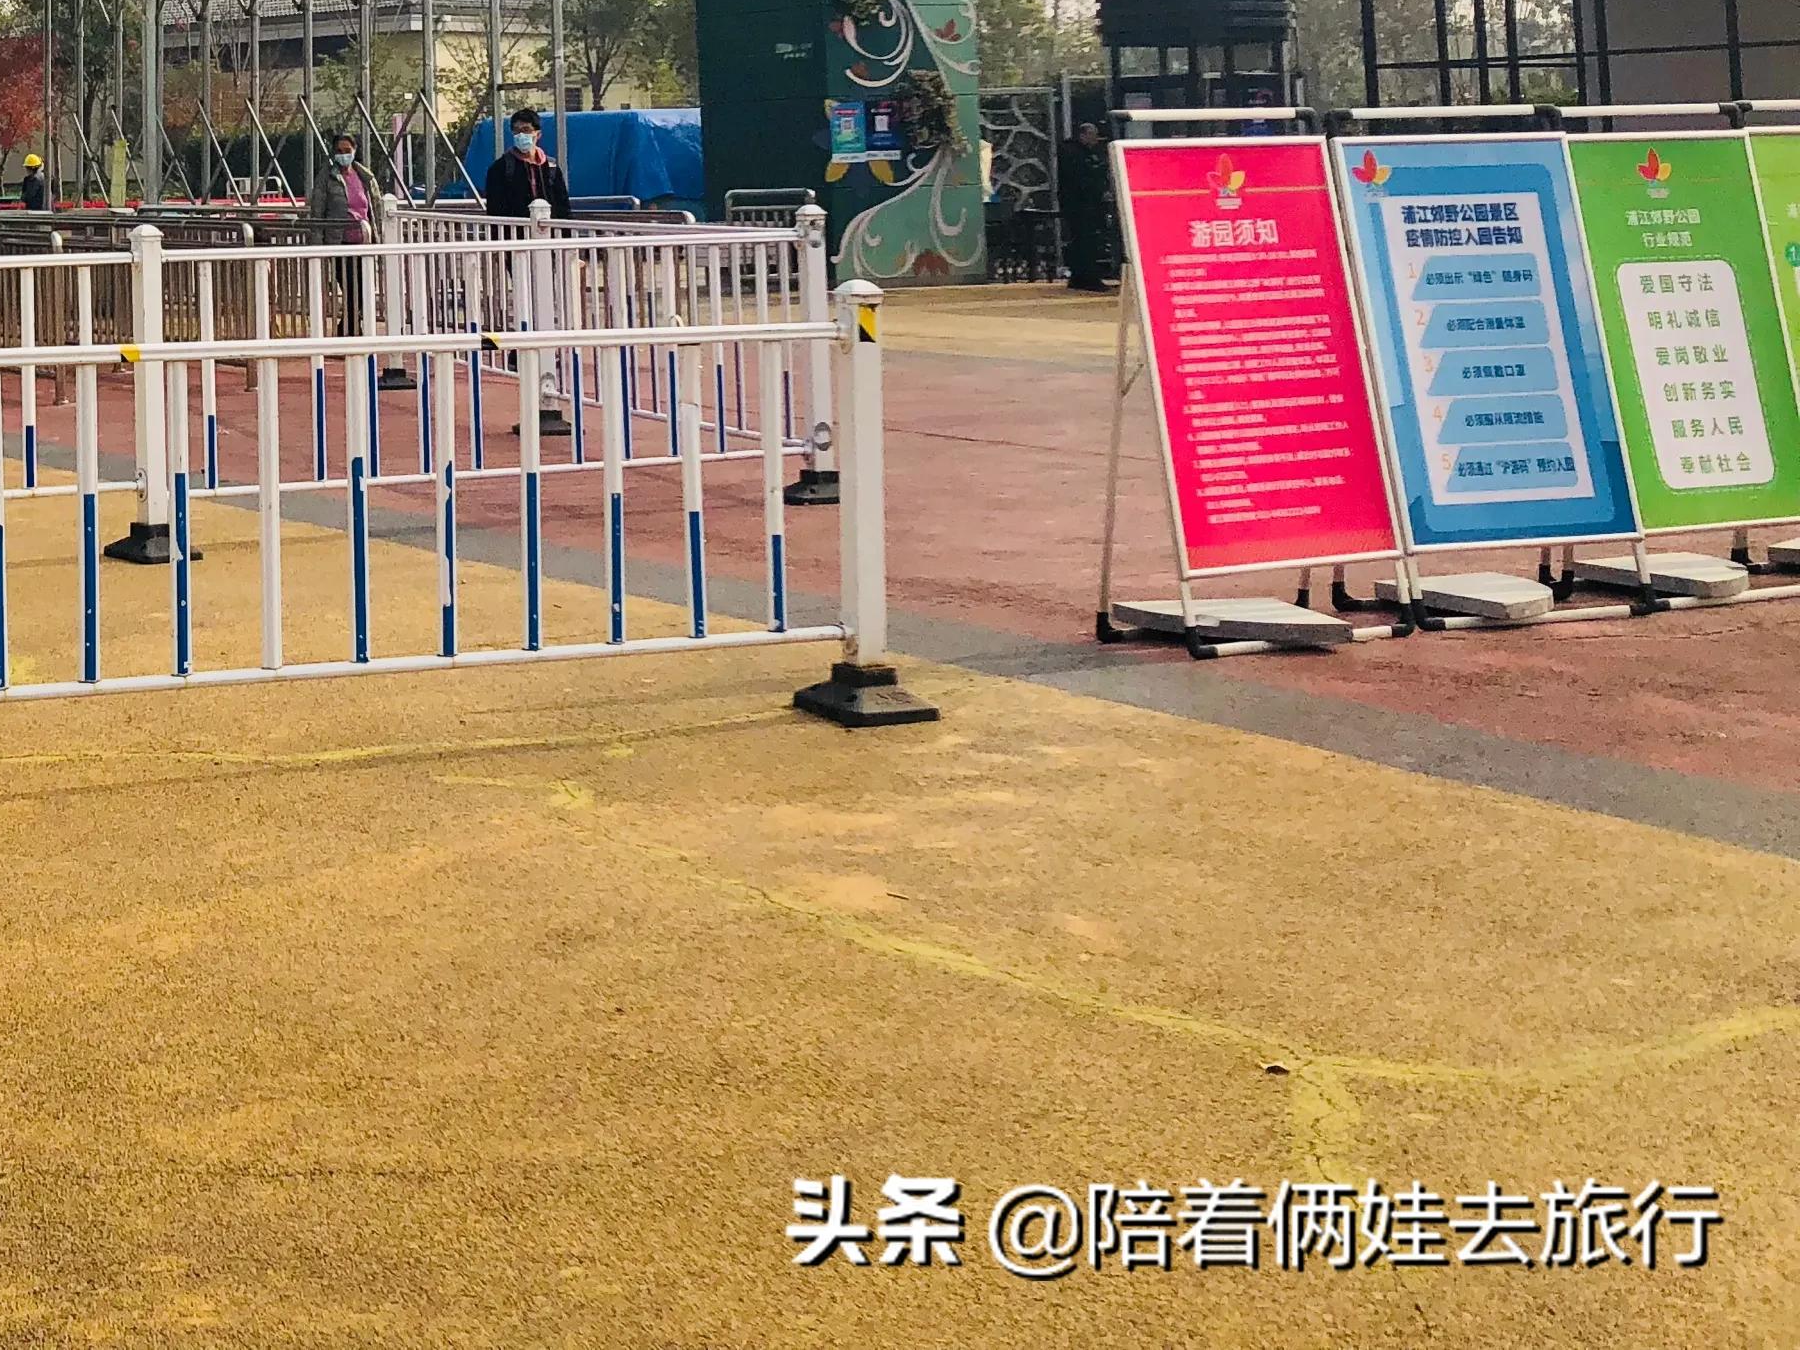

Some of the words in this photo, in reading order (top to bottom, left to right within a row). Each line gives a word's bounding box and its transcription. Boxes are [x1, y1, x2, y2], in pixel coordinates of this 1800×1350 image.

[1625, 208, 1701, 227] 浦江郊野公园
[1189, 219, 1279, 248] 游园须知
[1639, 272, 1714, 294] 爱国守法
[1647, 308, 1721, 330] 明礼诚信
[1654, 343, 1729, 366] 爱岗敬业
[1663, 380, 1737, 402] 创新务实
[1671, 415, 1744, 438] 服务人民
[1680, 451, 1752, 474] 奉献社会
